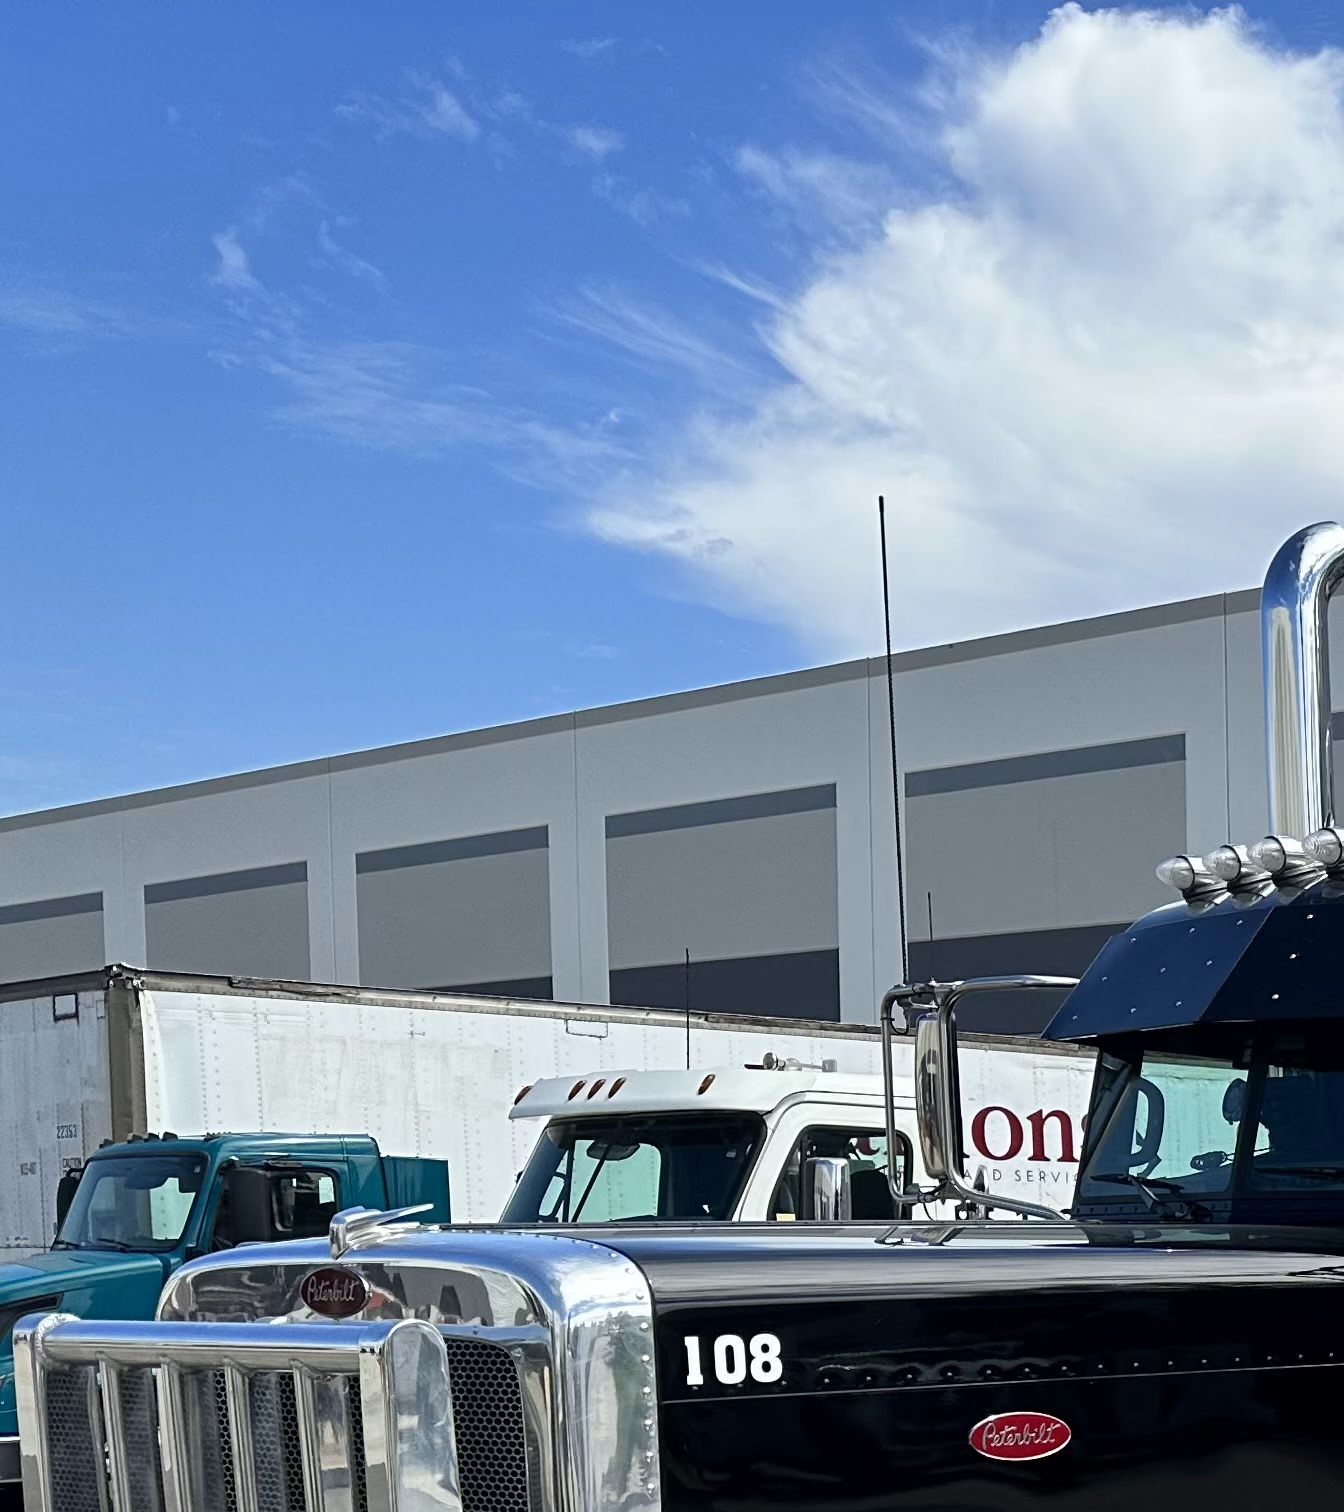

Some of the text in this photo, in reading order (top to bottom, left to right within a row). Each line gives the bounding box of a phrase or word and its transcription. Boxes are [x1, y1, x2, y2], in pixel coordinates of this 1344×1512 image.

[964, 1168, 1003, 1182] AD
[306, 1275, 360, 1305] Peterbilt
[684, 1333, 783, 1386] 108
[982, 1422, 1062, 1450] Peterbilt
